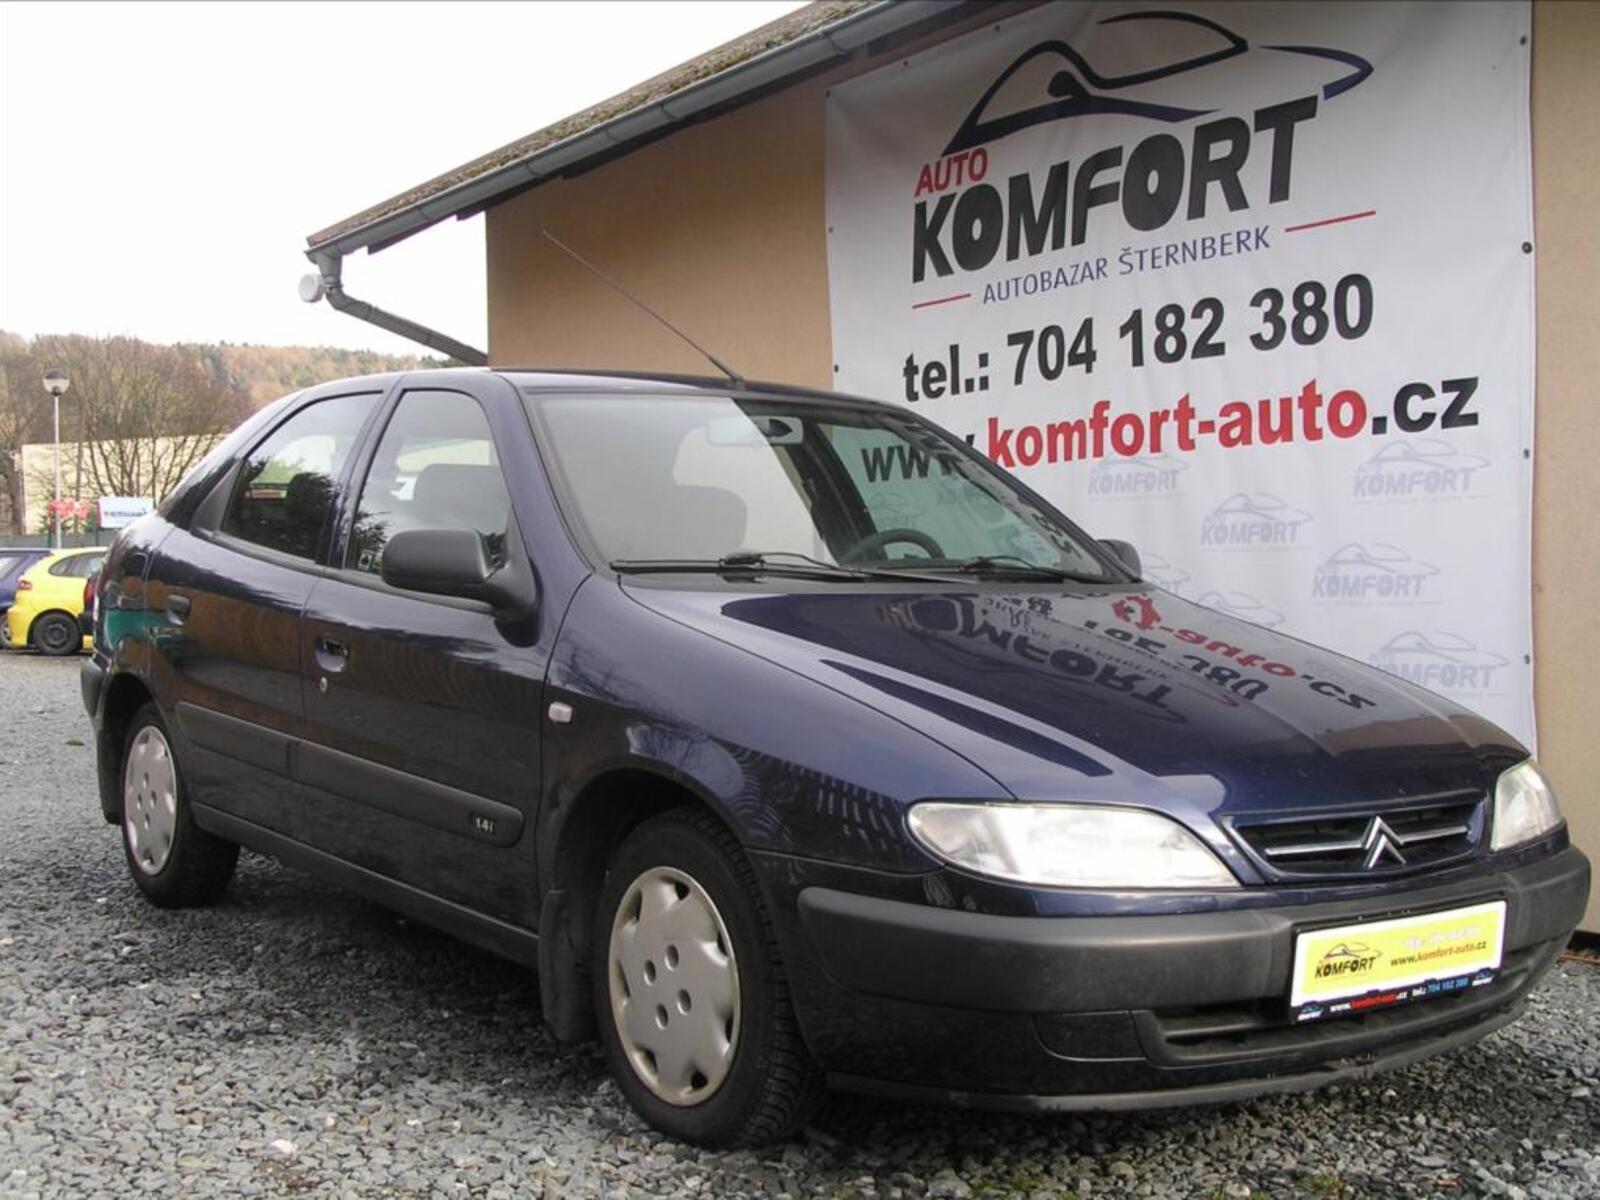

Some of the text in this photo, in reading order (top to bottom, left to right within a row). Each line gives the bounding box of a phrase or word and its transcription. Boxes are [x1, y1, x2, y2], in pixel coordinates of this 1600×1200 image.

[914, 148, 988, 197] AUTO
[912, 95, 1318, 284] KOMFORT
[983, 225, 1271, 304] AUTOBAZAR ŠTERNBERK
[903, 273, 1374, 402] tel.: 704 182 380
[1087, 470, 1178, 495] KOMFORT
[1352, 467, 1476, 498] KOMFORT
[1201, 521, 1303, 547] KOMFORT
[1311, 573, 1427, 599] KOMFORT
[1314, 956, 1377, 979] KOMFORT
